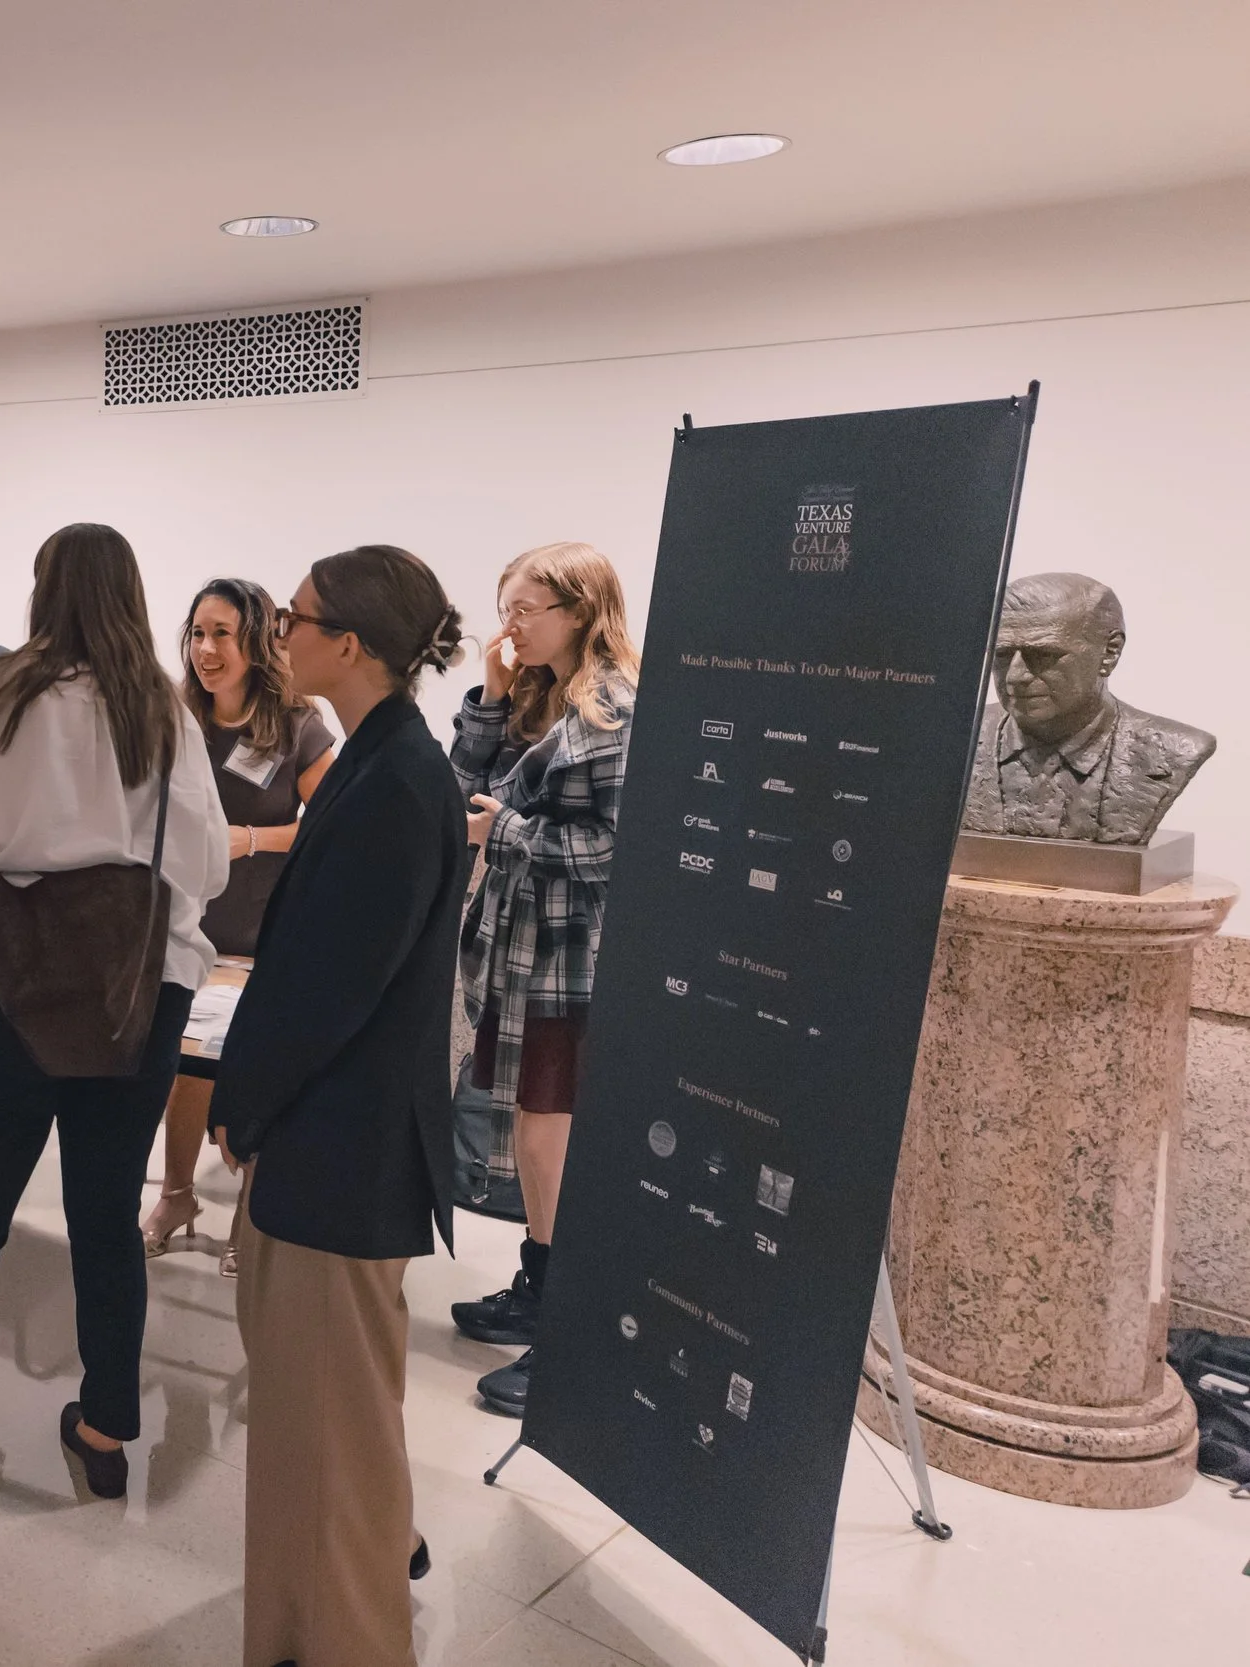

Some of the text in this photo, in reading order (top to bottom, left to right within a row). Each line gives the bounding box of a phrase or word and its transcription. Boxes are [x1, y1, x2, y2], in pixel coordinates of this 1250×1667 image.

[797, 504, 853, 521] TEXAS
[794, 521, 851, 534] VENTURE
[792, 536, 848, 555] GALA
[789, 556, 846, 572] FORUM
[680, 653, 937, 685] Made Possible Thanks To Our Major Partners
[706, 724, 729, 735] carta
[764, 729, 808, 742] Justworks
[680, 851, 715, 870] PCDC
[718, 950, 788, 981] Star Partners
[666, 976, 688, 992] MC3
[678, 1077, 781, 1128] Experience Partners
[648, 1279, 750, 1346] Community Partners
